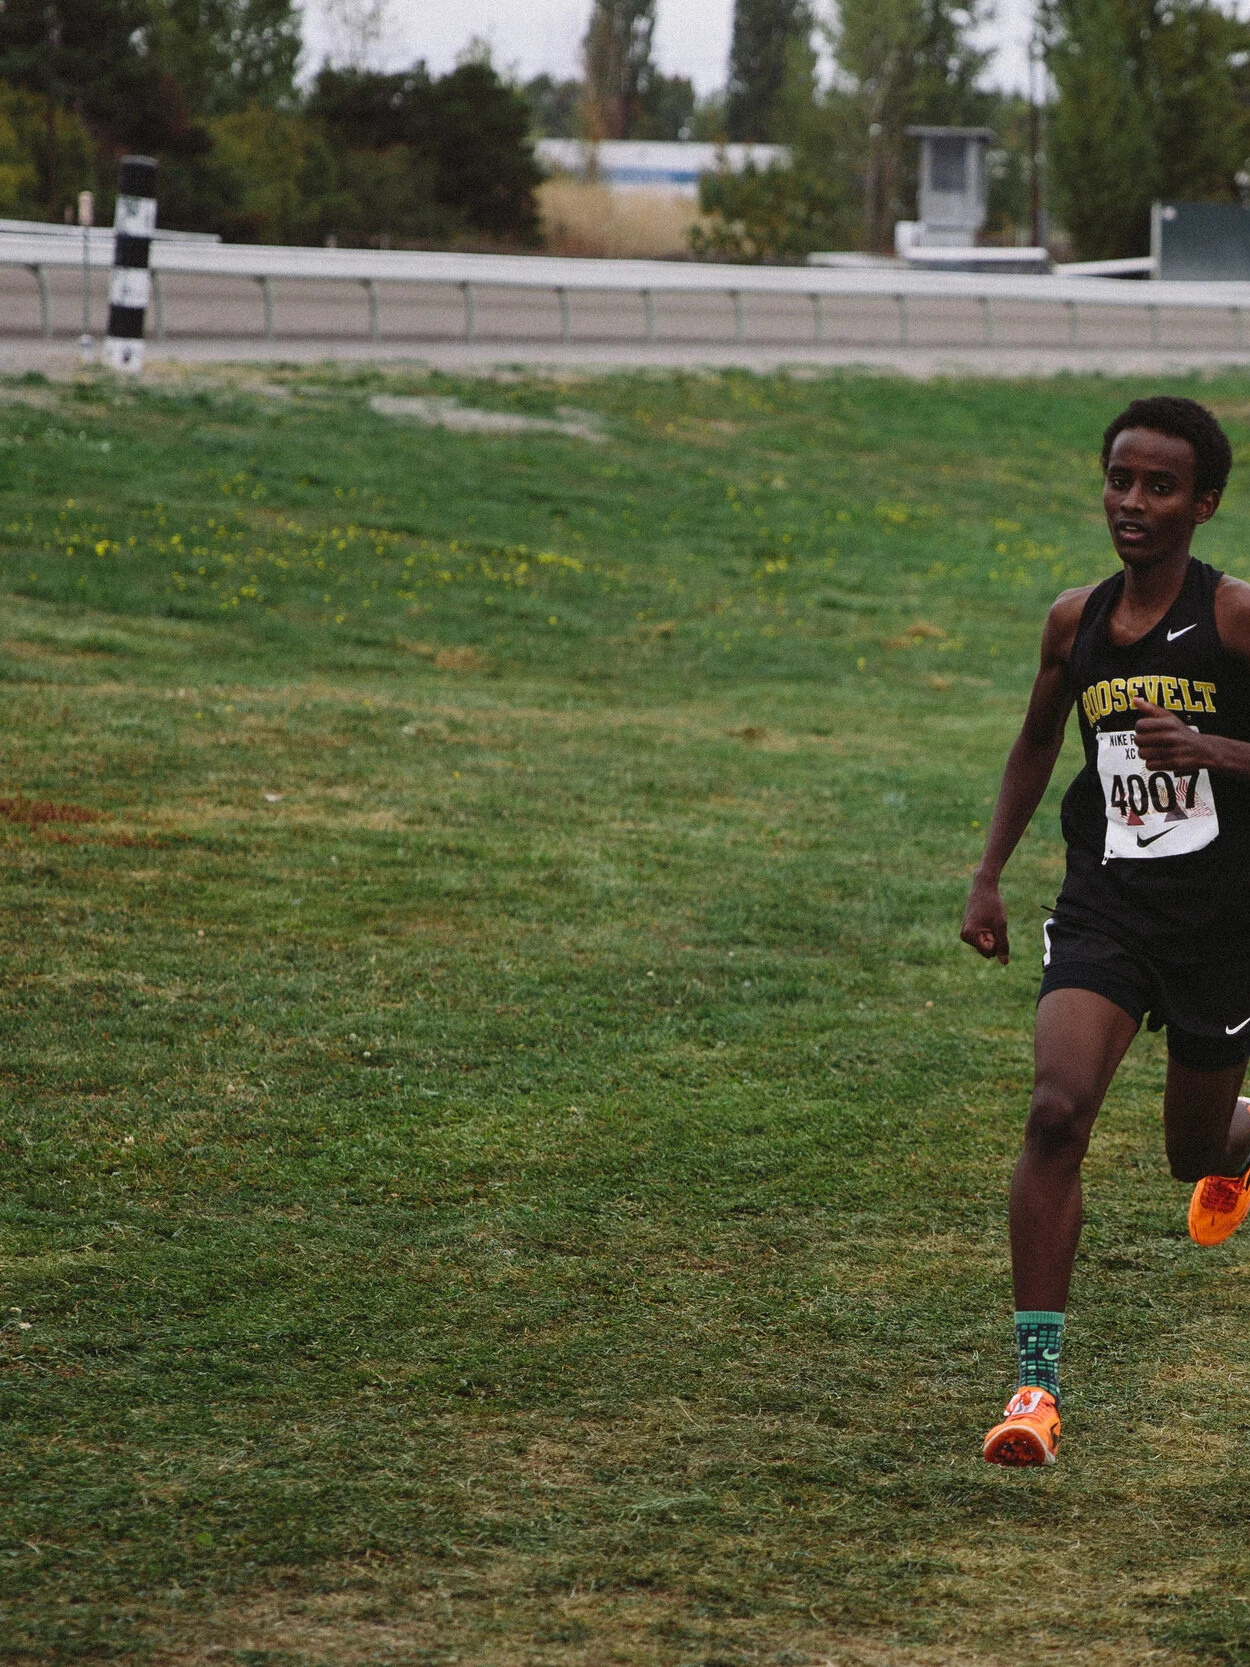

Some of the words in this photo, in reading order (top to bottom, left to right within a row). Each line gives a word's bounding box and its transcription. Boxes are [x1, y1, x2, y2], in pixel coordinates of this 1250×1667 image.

[1082, 676, 1216, 726] ROOSEVELT
[1110, 734, 1128, 746] NIKE
[1125, 748, 1136, 760] XC
[1111, 771, 1199, 816] 4007
